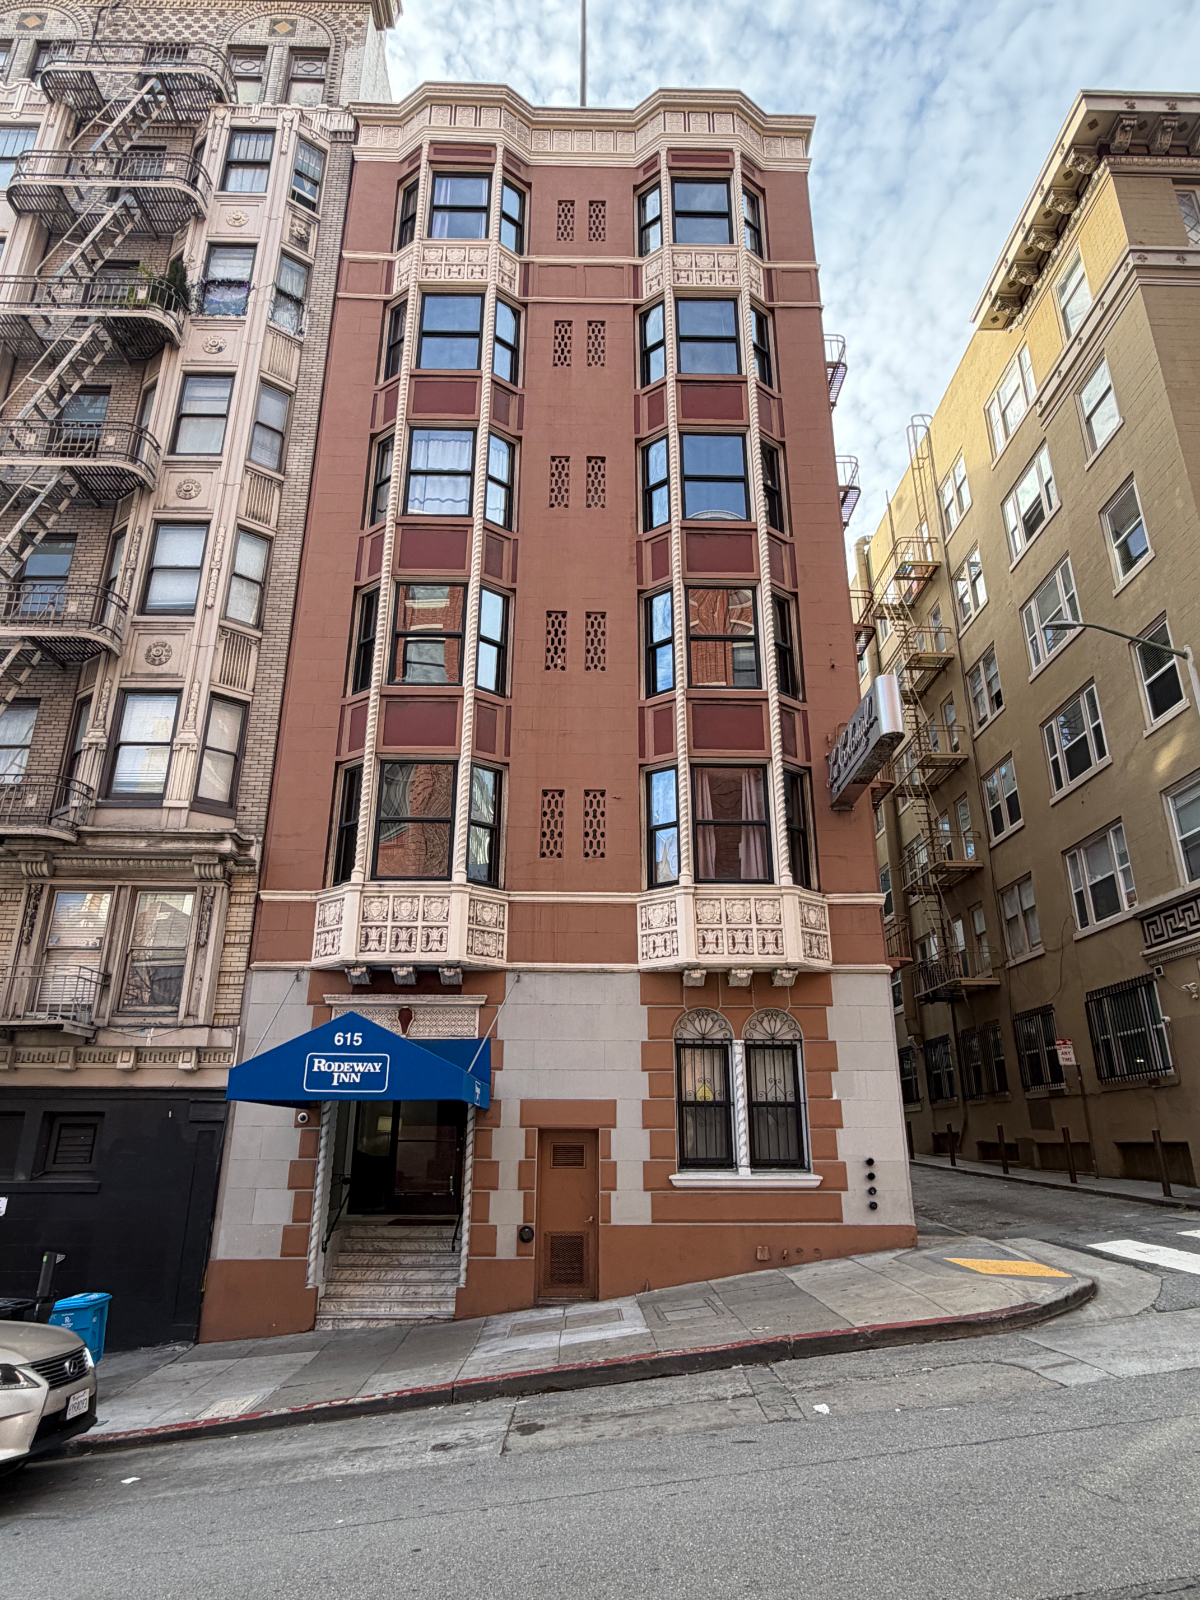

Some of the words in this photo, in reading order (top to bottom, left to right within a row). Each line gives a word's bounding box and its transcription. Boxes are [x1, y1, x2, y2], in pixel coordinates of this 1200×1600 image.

[334, 1032, 363, 1046] 615
[312, 1058, 383, 1073] RODEWAY
[331, 1072, 361, 1086] INN
